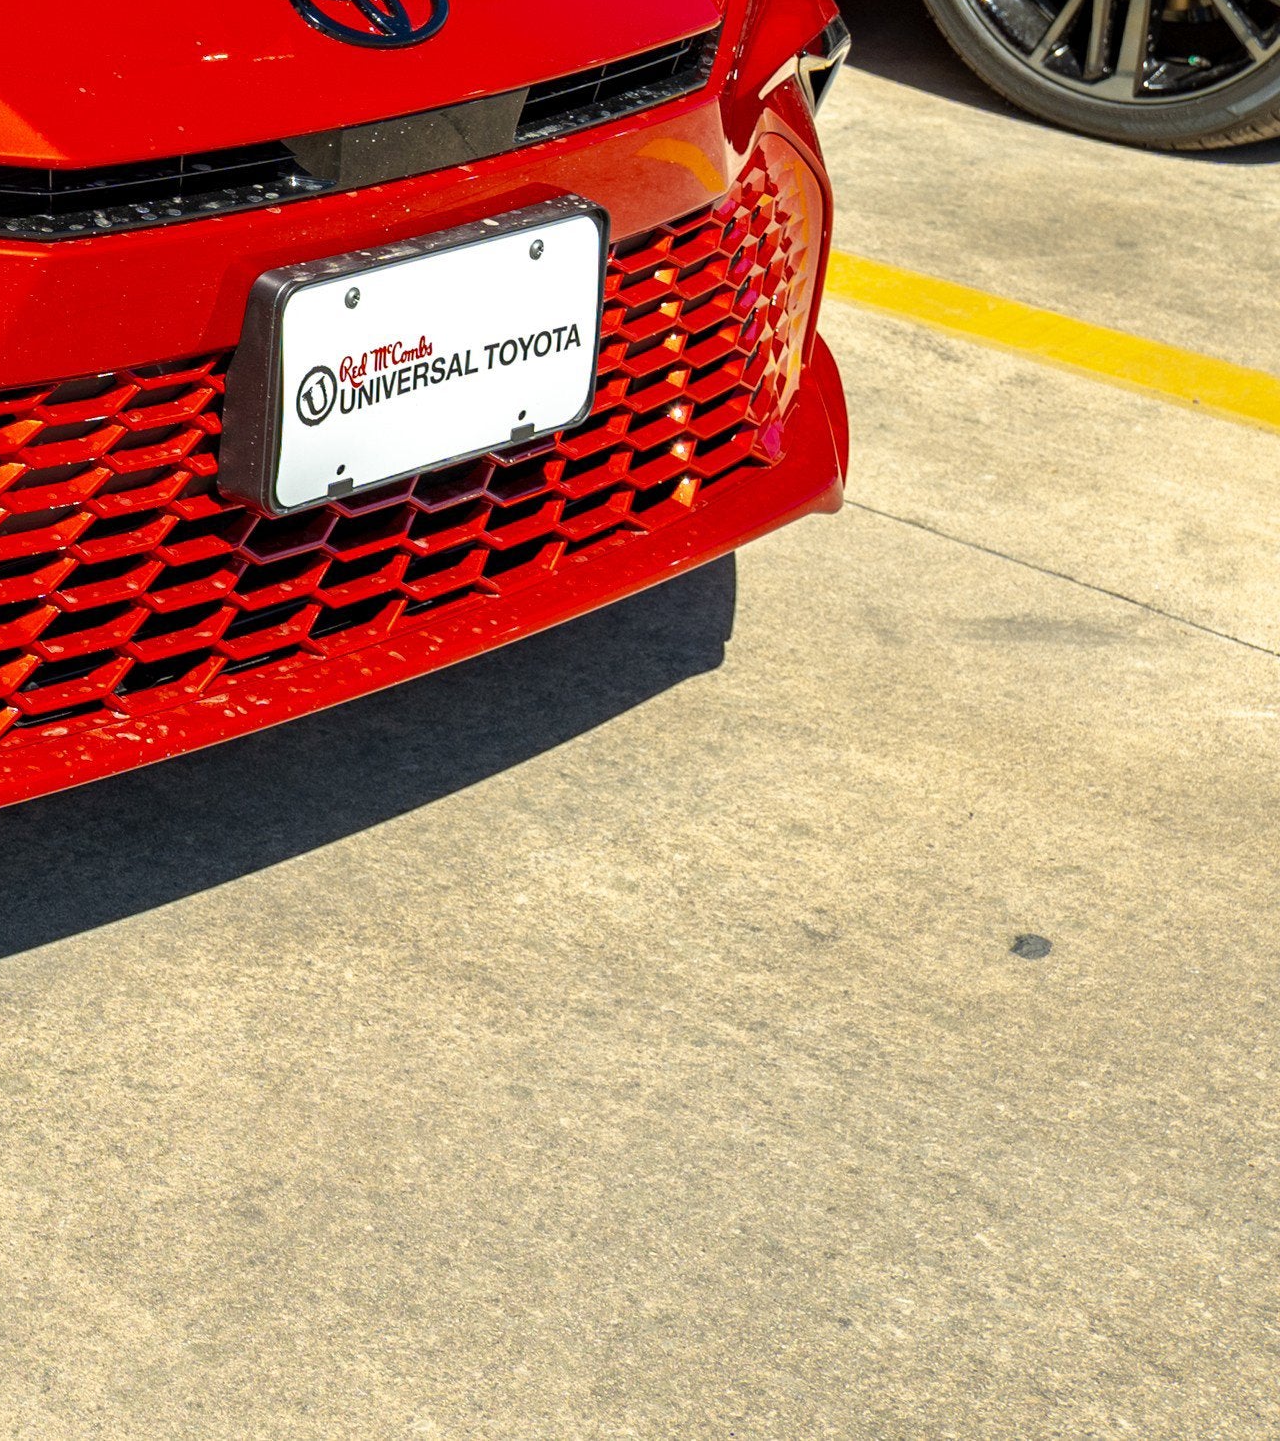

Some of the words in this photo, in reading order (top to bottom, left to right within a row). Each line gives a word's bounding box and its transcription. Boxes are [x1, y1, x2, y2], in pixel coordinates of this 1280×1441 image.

[338, 349, 480, 416] UNIVERSAL
[483, 323, 582, 371] TOYOTA
[339, 353, 368, 389] Red
[370, 335, 434, 372] McCombs
